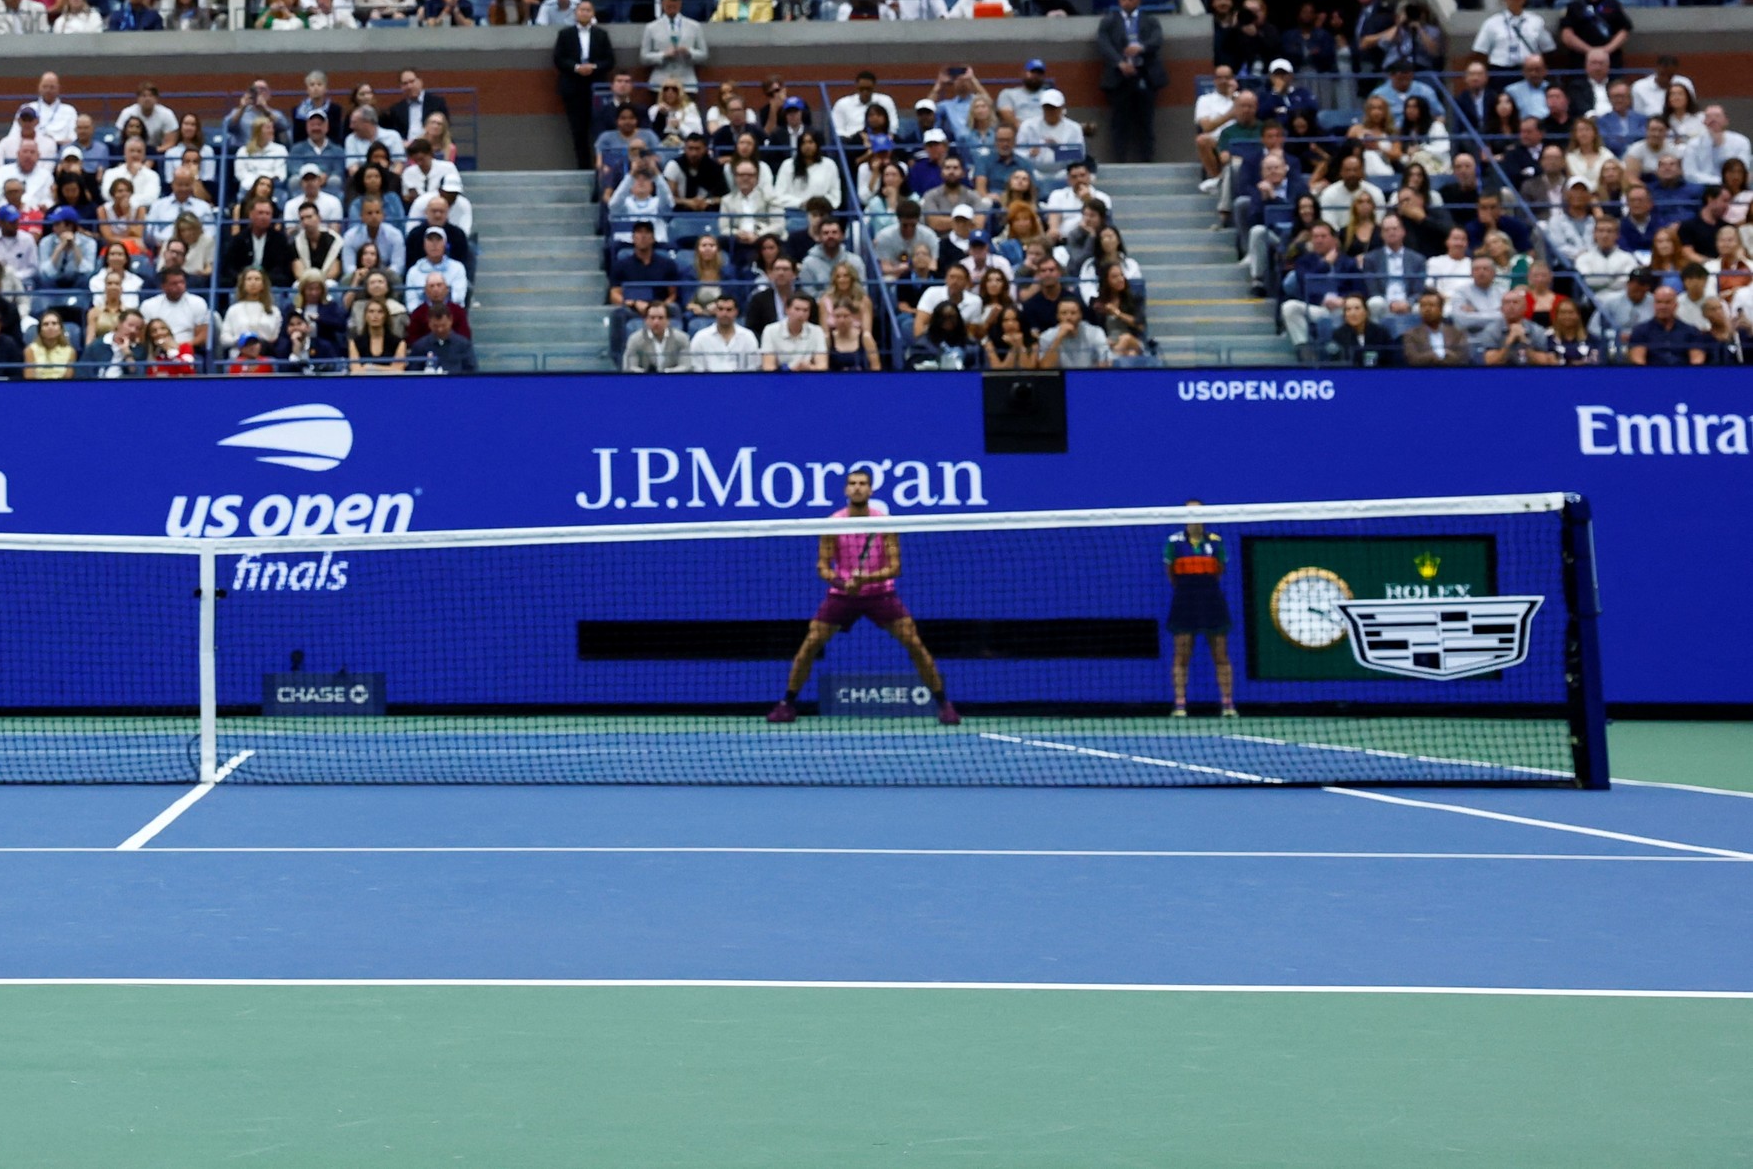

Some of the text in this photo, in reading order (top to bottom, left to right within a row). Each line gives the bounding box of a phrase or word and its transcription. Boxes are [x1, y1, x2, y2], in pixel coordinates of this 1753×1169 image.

[1178, 379, 1336, 401] USOPEN.ORG
[1575, 402, 1753, 455] Emira
[165, 492, 415, 537] us open
[231, 552, 350, 592] finals
[1384, 583, 1472, 598] ROLEX
[276, 686, 346, 703] CHASE
[837, 687, 909, 704] CHASE
